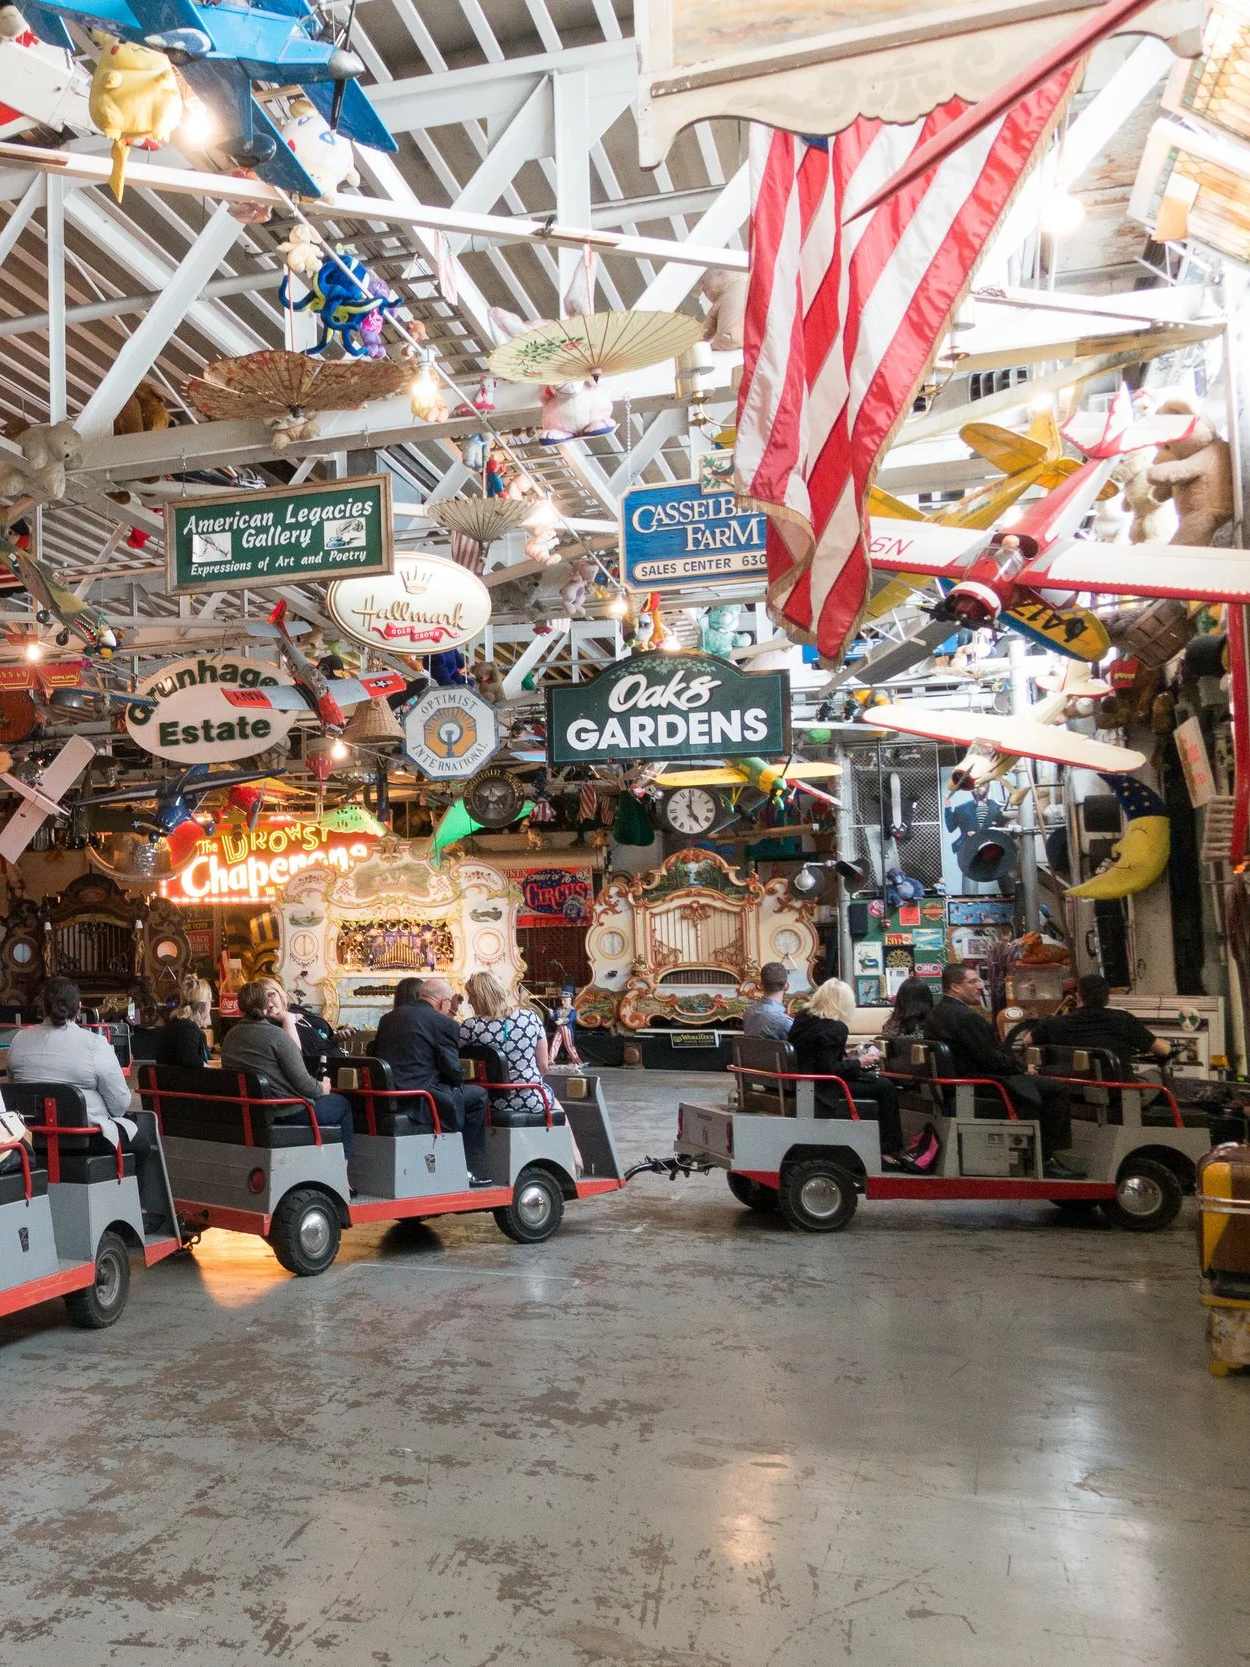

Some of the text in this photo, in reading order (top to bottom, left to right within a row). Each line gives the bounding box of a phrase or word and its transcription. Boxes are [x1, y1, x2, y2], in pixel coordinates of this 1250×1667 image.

[183, 498, 374, 535] American Legacies
[242, 526, 312, 548] Gallery
[191, 549, 367, 577] Expressions of Art and Poetry
[641, 563, 677, 577] SALES
[683, 558, 732, 573] CENTER
[351, 594, 470, 632] Hallmark
[391, 627, 440, 640] GOLD CROWN
[127, 660, 290, 727] Grunhage
[420, 694, 478, 715] OPTIMIST
[608, 670, 722, 713] Oaks
[159, 716, 271, 746] Estate
[566, 708, 768, 751] GARDENS
[412, 743, 488, 771] INTERNATIONAL
[196, 839, 218, 855] The
[525, 882, 585, 910] CIRCUS
